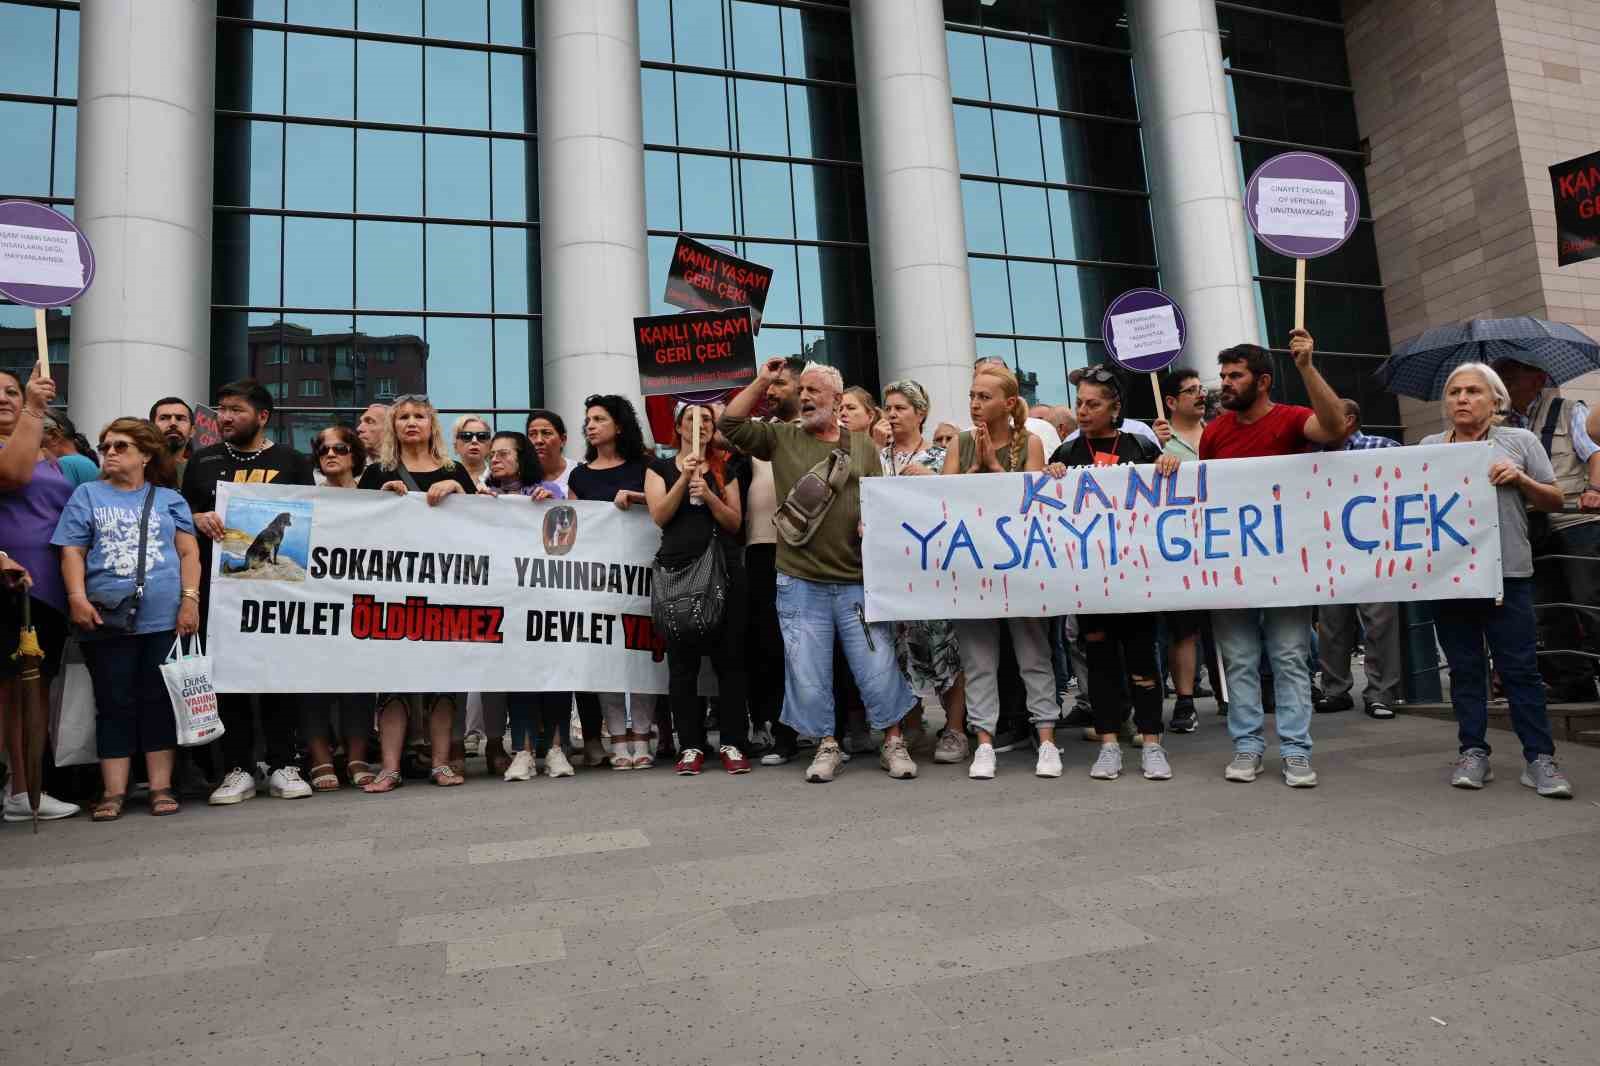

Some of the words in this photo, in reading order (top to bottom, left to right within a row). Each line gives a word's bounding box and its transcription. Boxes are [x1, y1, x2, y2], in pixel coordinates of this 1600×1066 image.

[678, 244, 718, 272] KANLI
[640, 323, 688, 344] KANLI
[655, 344, 692, 364] GERİ
[696, 341, 732, 364] ÇEK!
[1020, 463, 1208, 515] KANLI
[902, 512, 1118, 571] YASAYI
[1156, 483, 1285, 562] GERİ
[310, 546, 490, 586] SOKAKTAYIM
[515, 557, 653, 597] YANINDAYI
[240, 600, 344, 635] DEVLET
[351, 594, 504, 643] ÖLDÜRMEZ
[526, 610, 616, 645] DEVLET
